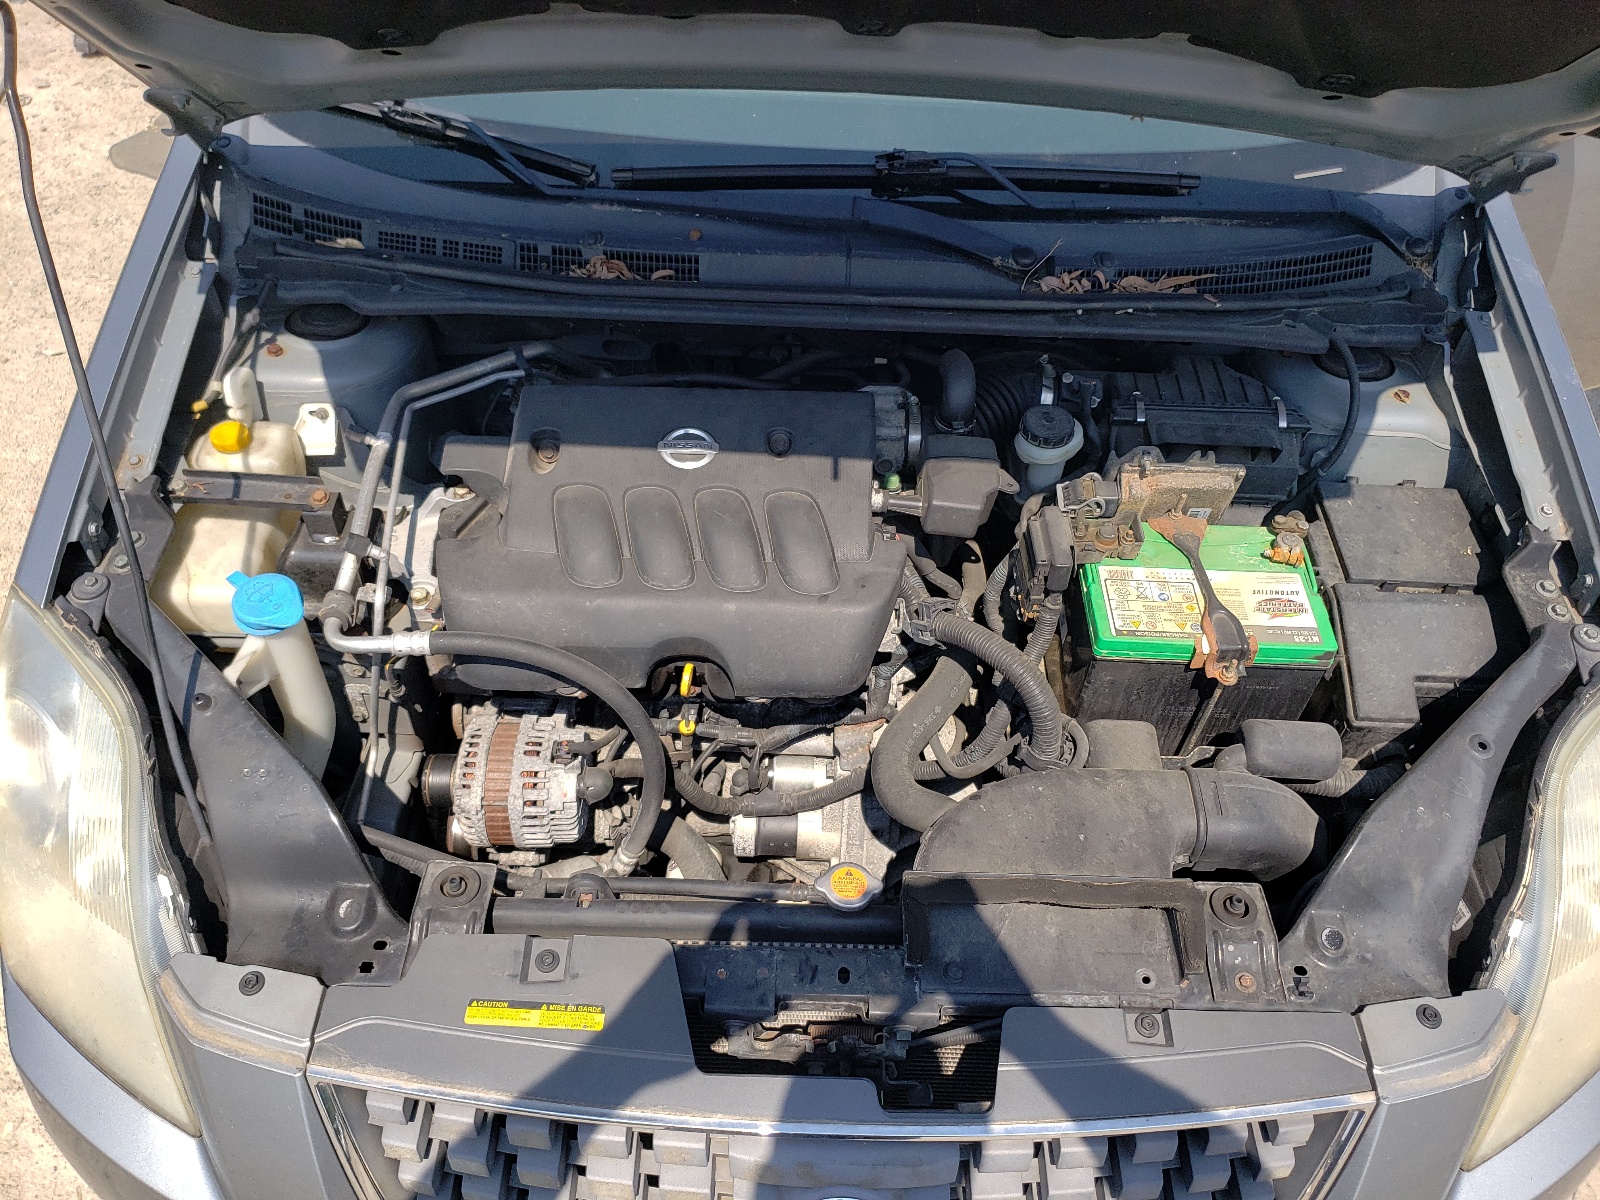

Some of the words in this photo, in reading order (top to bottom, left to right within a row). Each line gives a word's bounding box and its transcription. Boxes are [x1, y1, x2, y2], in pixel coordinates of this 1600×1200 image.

[663, 441, 713, 449] NISSAN
[1252, 589, 1300, 597] AUTOMOTIVE
[1253, 606, 1308, 615] INTERSTATE
[478, 1000, 509, 1008] CAUTION
[577, 1005, 602, 1013] GARDE
